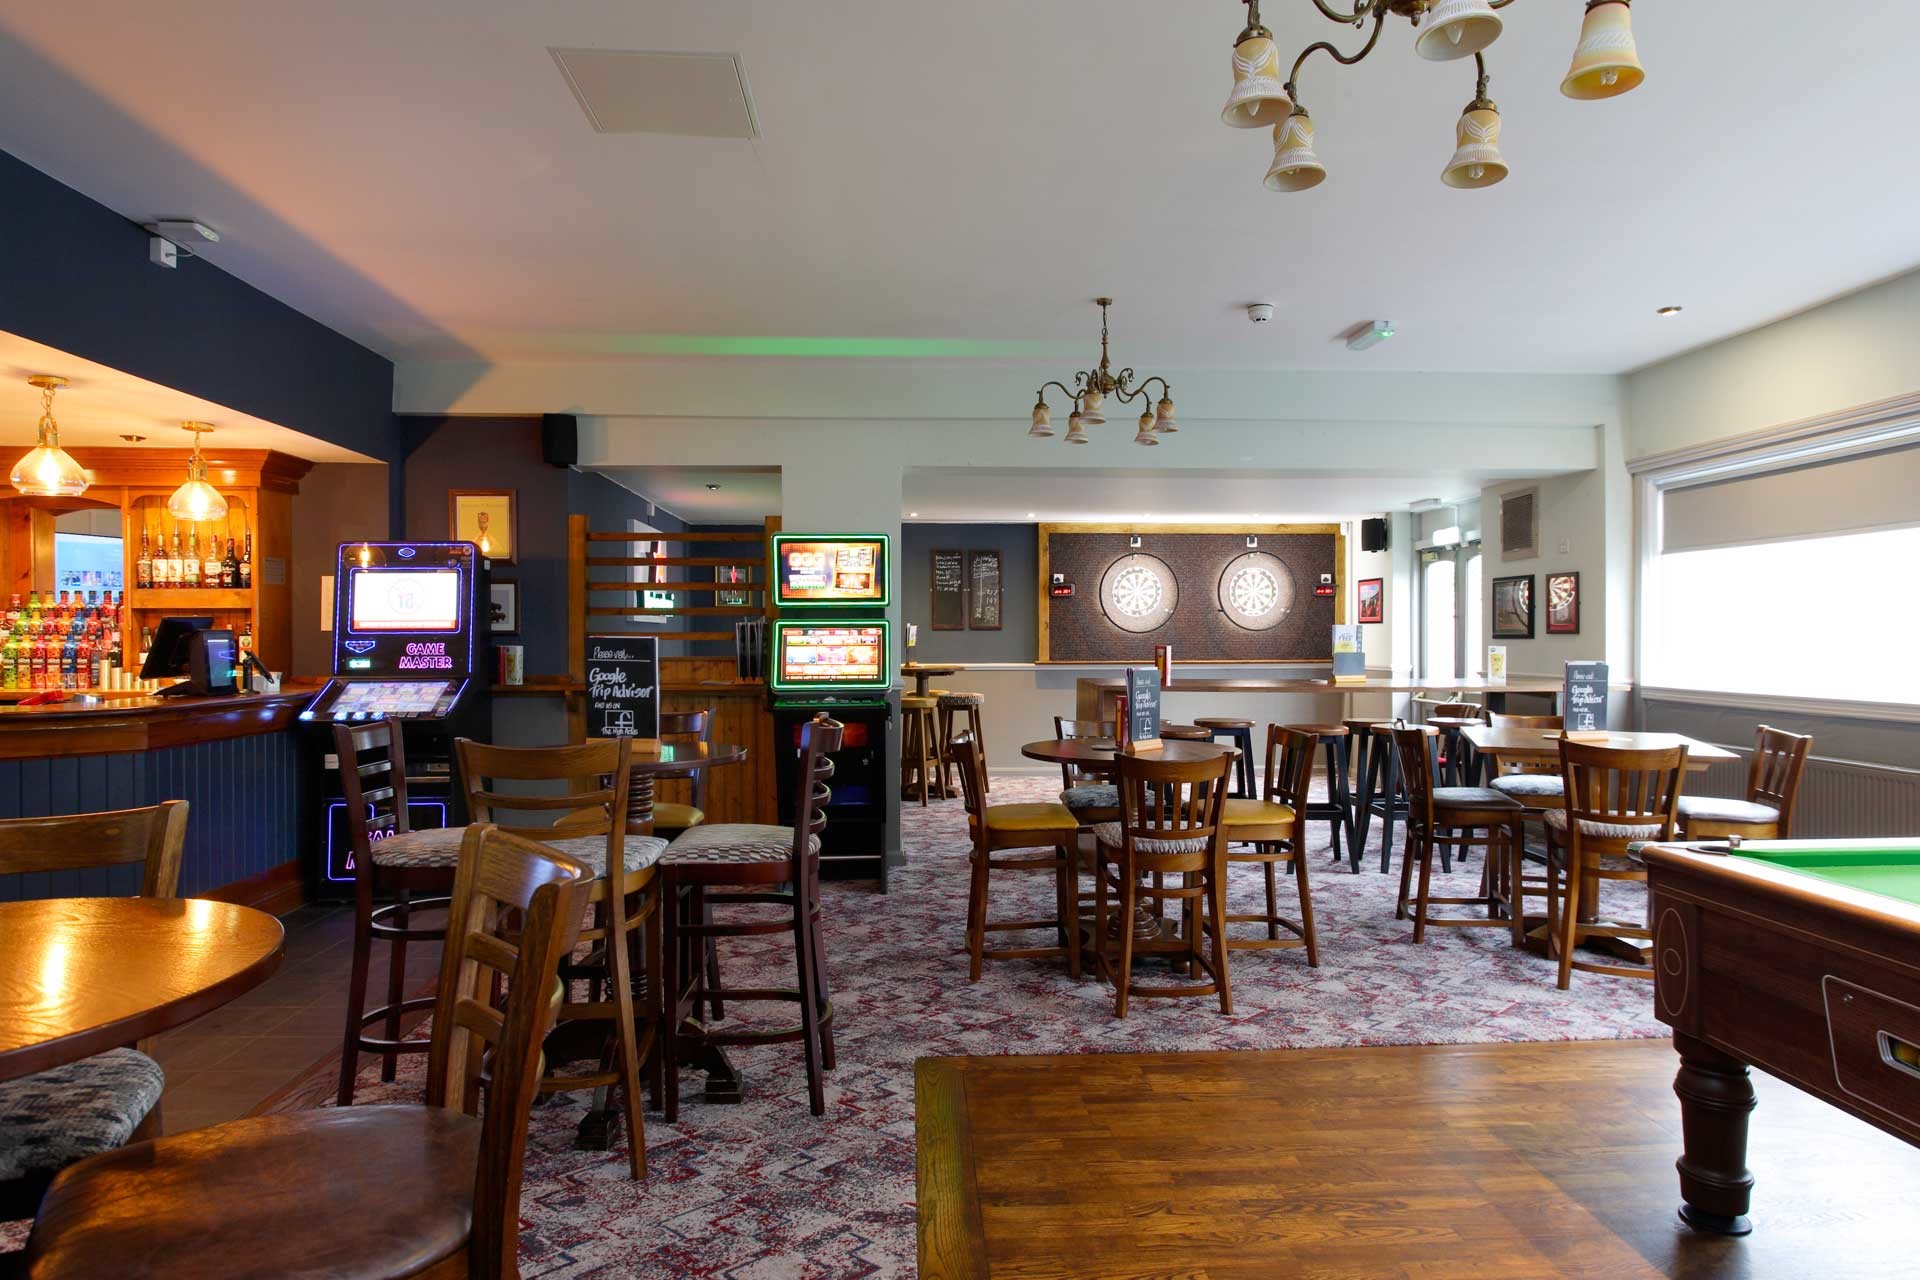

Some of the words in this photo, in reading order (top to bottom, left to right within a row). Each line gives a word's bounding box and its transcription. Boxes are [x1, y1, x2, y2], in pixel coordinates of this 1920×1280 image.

[406, 642, 445, 656] GAME
[398, 656, 453, 669] MASTER
[588, 666, 627, 685] Google
[588, 683, 612, 700] Trip
[612, 682, 655, 699] Advisor
